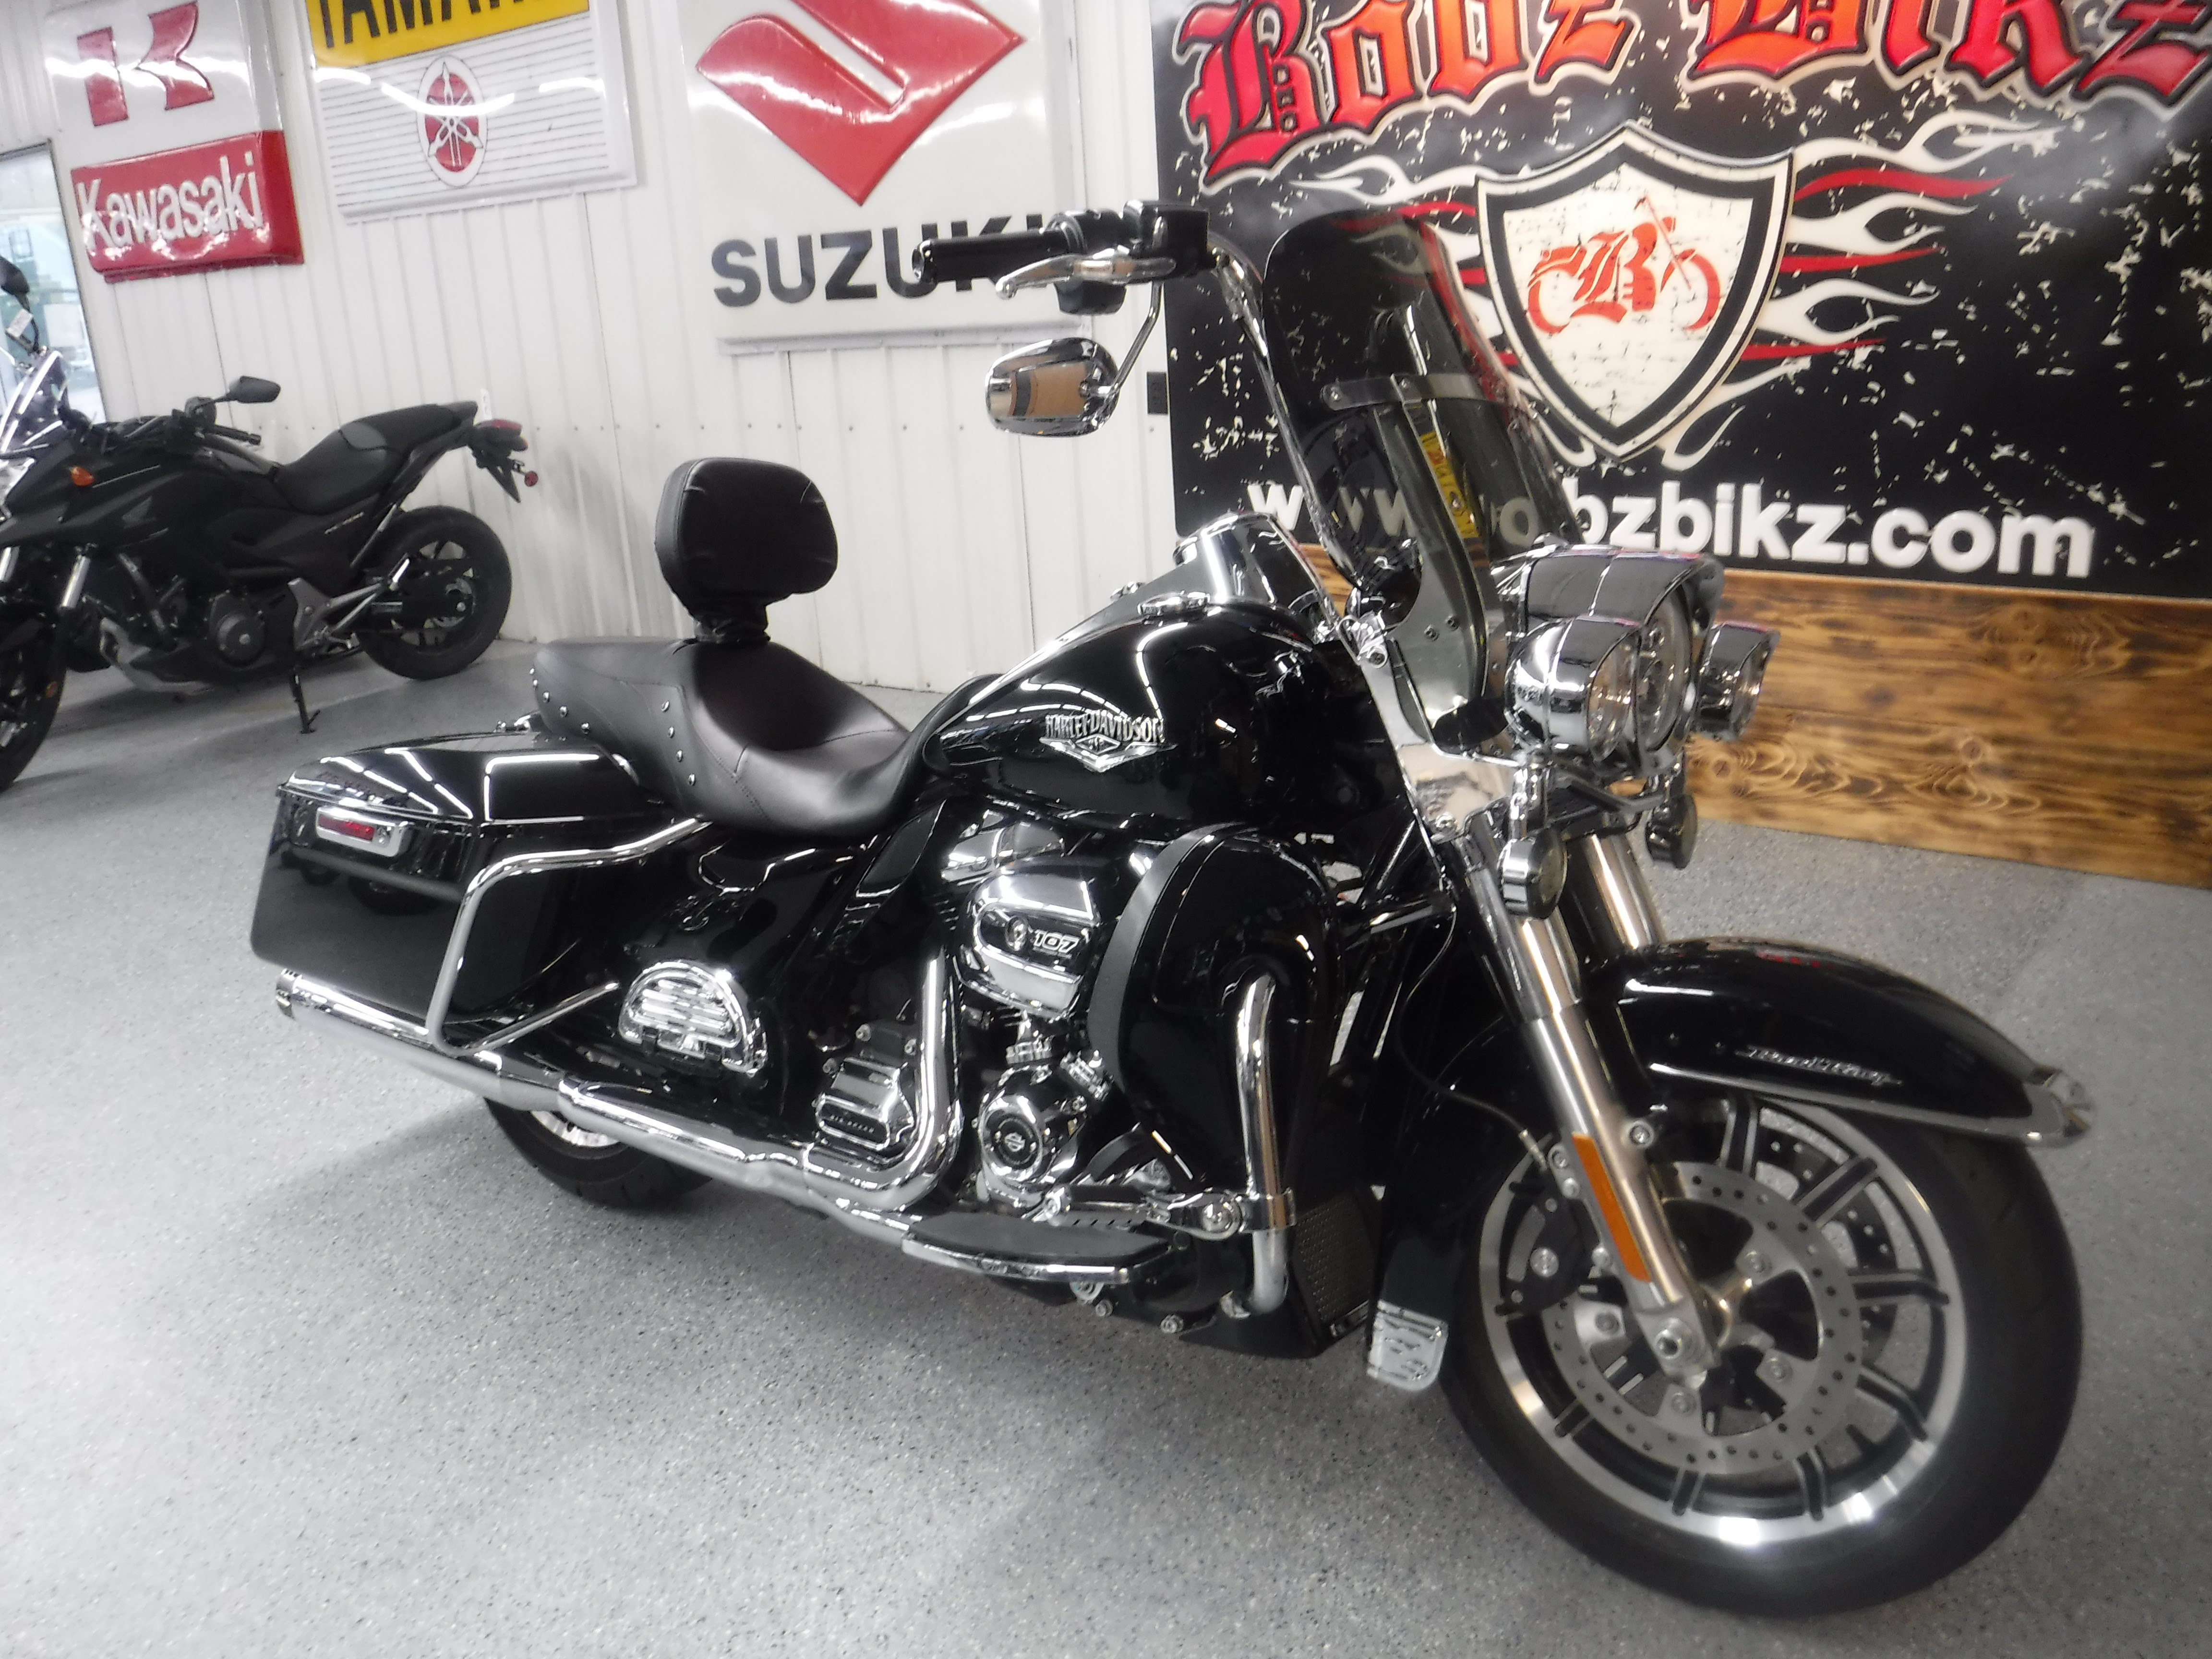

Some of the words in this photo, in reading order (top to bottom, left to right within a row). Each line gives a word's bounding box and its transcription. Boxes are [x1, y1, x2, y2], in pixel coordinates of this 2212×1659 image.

[76, 150, 265, 252] Kawasaki
[710, 213, 1045, 308] SUZU
[1033, 929, 1080, 953] 107
